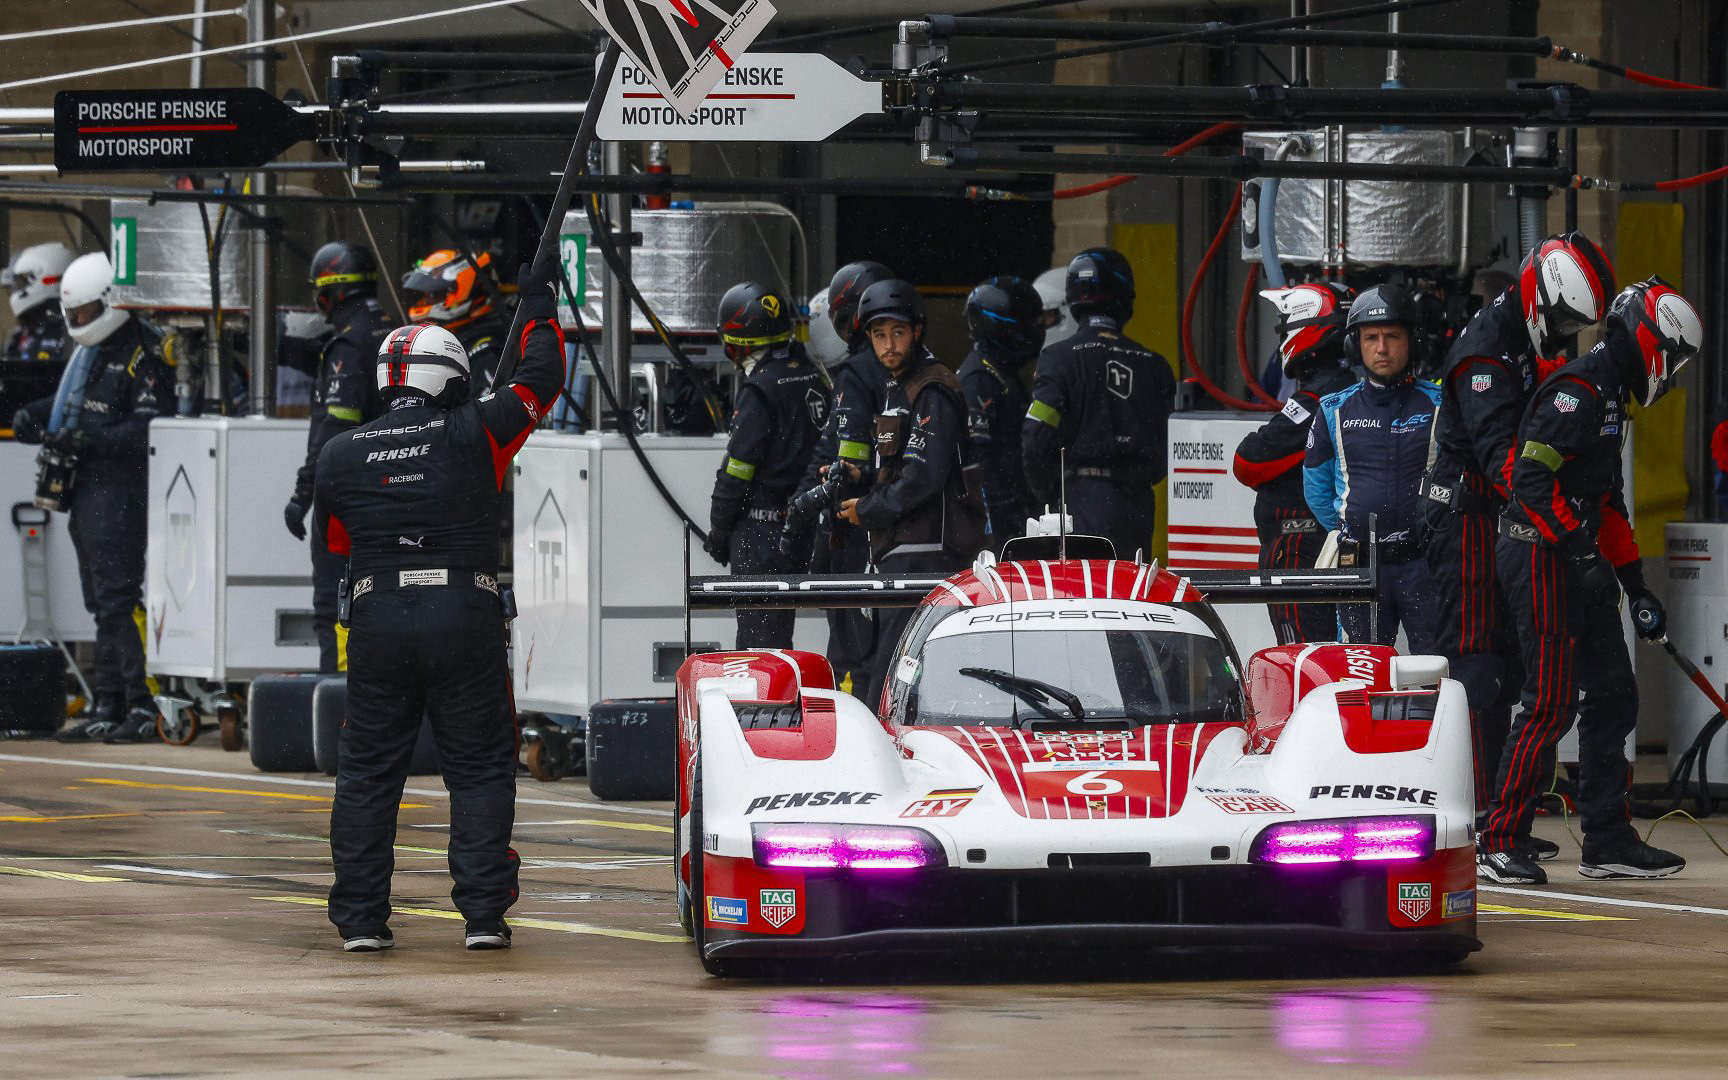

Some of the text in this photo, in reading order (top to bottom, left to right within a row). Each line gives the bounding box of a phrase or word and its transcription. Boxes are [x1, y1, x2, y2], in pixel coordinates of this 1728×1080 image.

[724, 67, 783, 86] ENSKE
[78, 100, 227, 121] PORSCHE PENSKE
[78, 138, 194, 157] MOTORSPORT
[1558, 393, 1579, 404] TAG
[352, 419, 445, 441] PORSCHE
[1342, 419, 1382, 429] OFFICIAL
[366, 444, 432, 463] PENSKE
[1173, 442, 1224, 461] PORSCHE PENSKE
[388, 473, 424, 484] RACEBORN
[1173, 481, 1213, 500] MOTORSPORT
[538, 540, 562, 601] TF
[968, 610, 1176, 626] PORSCHE
[1066, 770, 1124, 796] 6
[744, 791, 883, 815] PENSKE
[1309, 784, 1438, 807] PENSKE
[902, 800, 965, 817] HY
[1222, 802, 1289, 812] CAR
[762, 892, 793, 904] TAG
[1402, 885, 1430, 898] TAG
[762, 906, 793, 925] HEUER
[1401, 900, 1430, 918] HEUER
